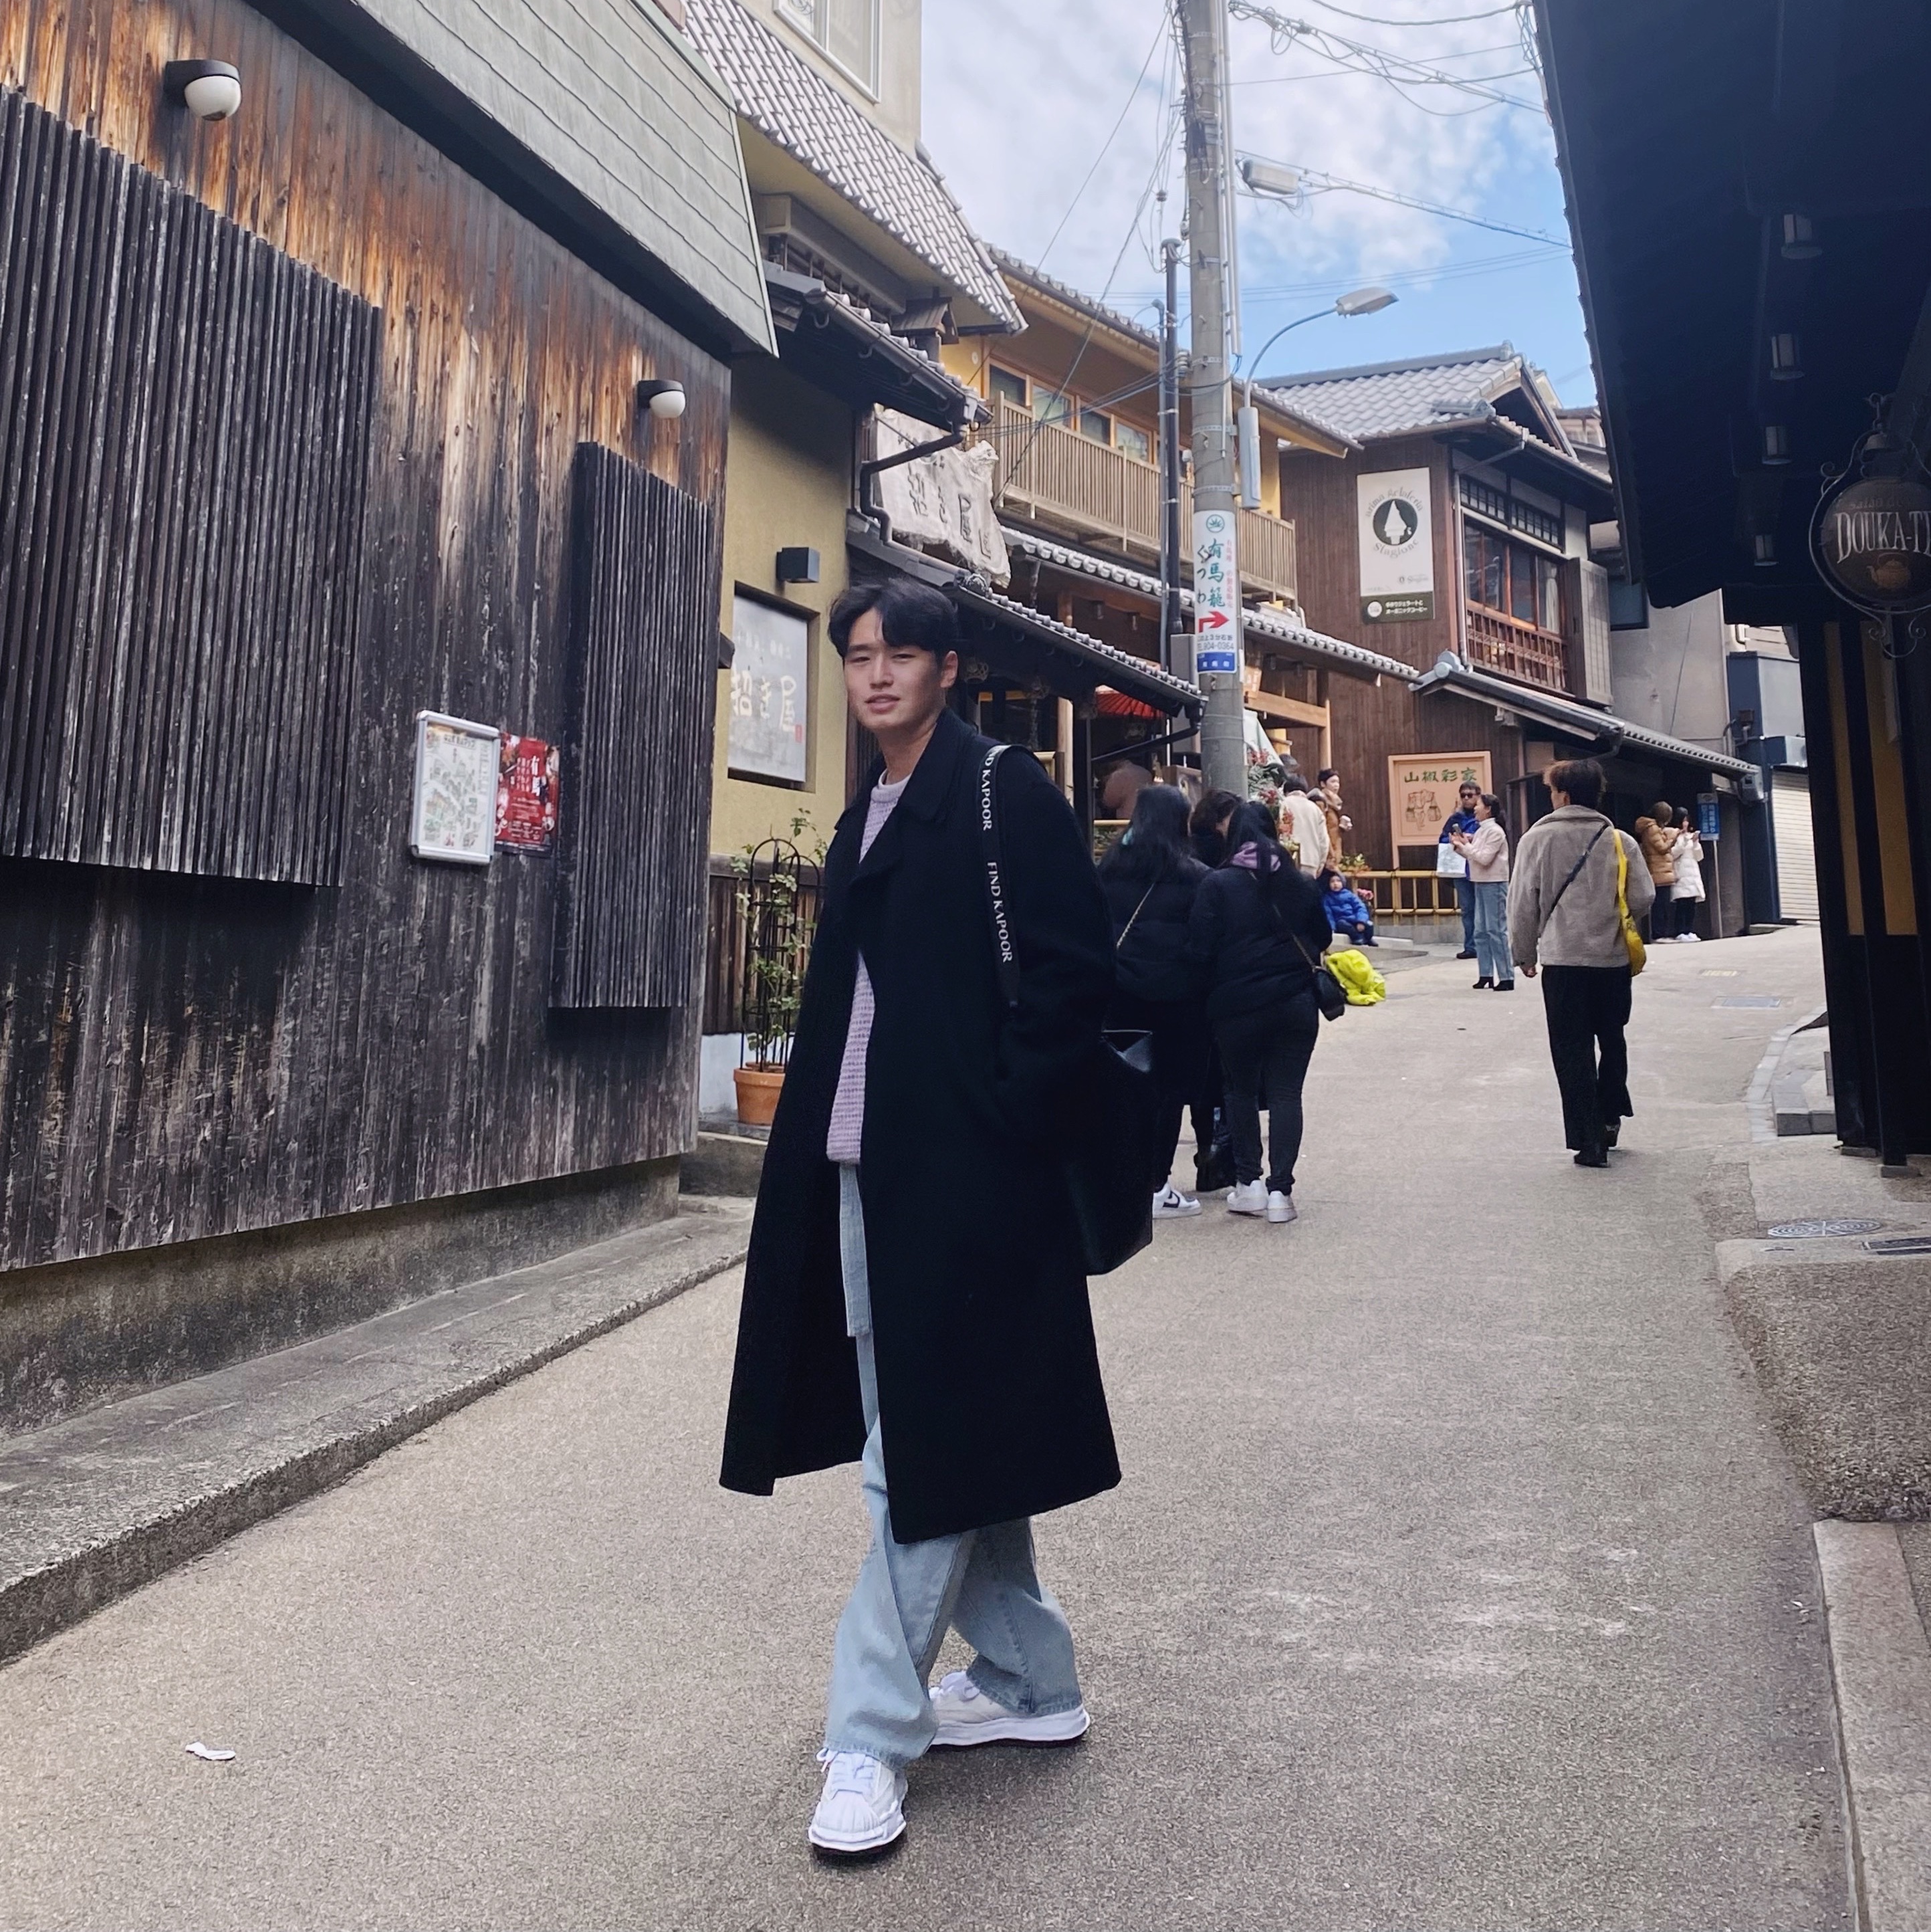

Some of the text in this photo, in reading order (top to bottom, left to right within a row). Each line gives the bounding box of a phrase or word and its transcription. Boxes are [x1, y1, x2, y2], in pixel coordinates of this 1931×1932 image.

[1208, 538, 1226, 607] 有馬籠
[982, 768, 992, 831] KAPOOR
[987, 861, 1013, 962] FIND KAPOOR
